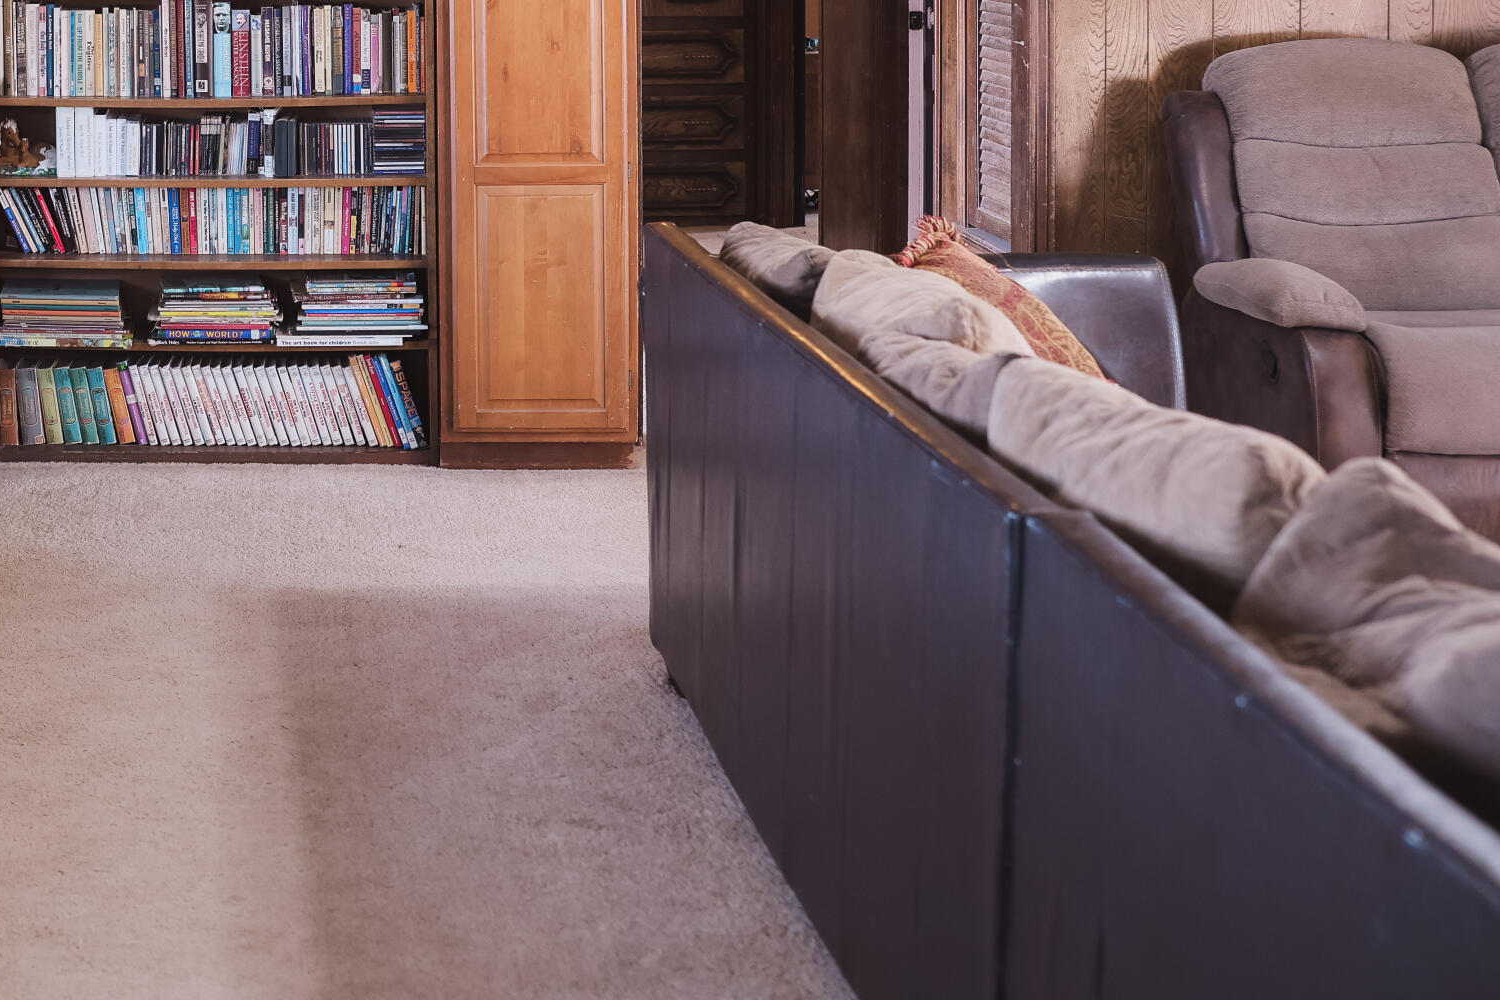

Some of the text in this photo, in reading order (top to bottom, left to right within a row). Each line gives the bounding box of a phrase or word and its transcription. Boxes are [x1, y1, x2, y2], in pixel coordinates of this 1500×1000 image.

[239, 32, 250, 87] EINSTEIN
[206, 331, 243, 339] WORLD?
[395, 373, 417, 418] SPACE
